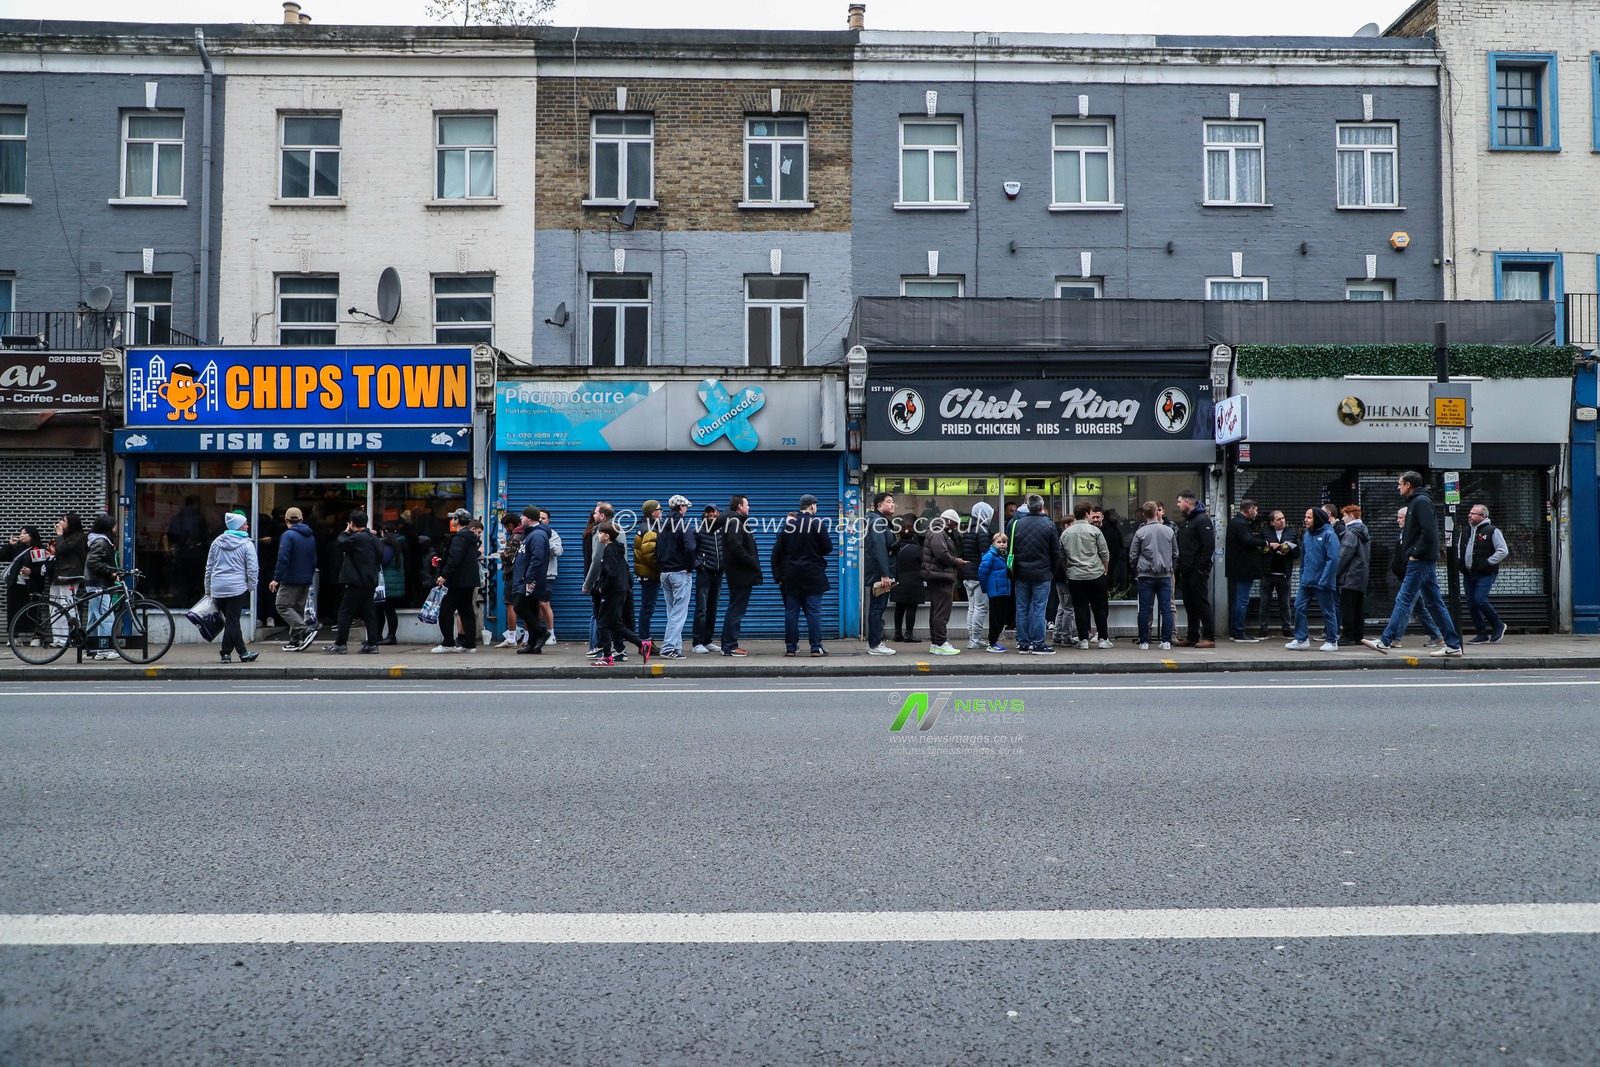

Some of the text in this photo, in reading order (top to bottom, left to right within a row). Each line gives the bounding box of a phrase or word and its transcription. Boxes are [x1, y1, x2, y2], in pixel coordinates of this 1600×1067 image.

[0, 365, 46, 387] ar
[225, 364, 467, 410] CHIPS TOWN
[13, 394, 54, 402] Coffee
[62, 394, 99, 402] Cakes
[505, 388, 625, 404] Pharmocare
[939, 388, 1028, 420] Chick
[1059, 387, 1140, 425] King
[1367, 406, 1388, 417] THE
[1392, 406, 1421, 417] NAIL
[697, 393, 759, 439] Pharmocare
[941, 423, 972, 435] FRIED
[975, 423, 1021, 435] CHICKEN
[1036, 423, 1060, 435] RIBS
[1075, 423, 1123, 435] BURGERS
[200, 432, 382, 450] FISH & CHIPS
[781, 437, 797, 446] 753
